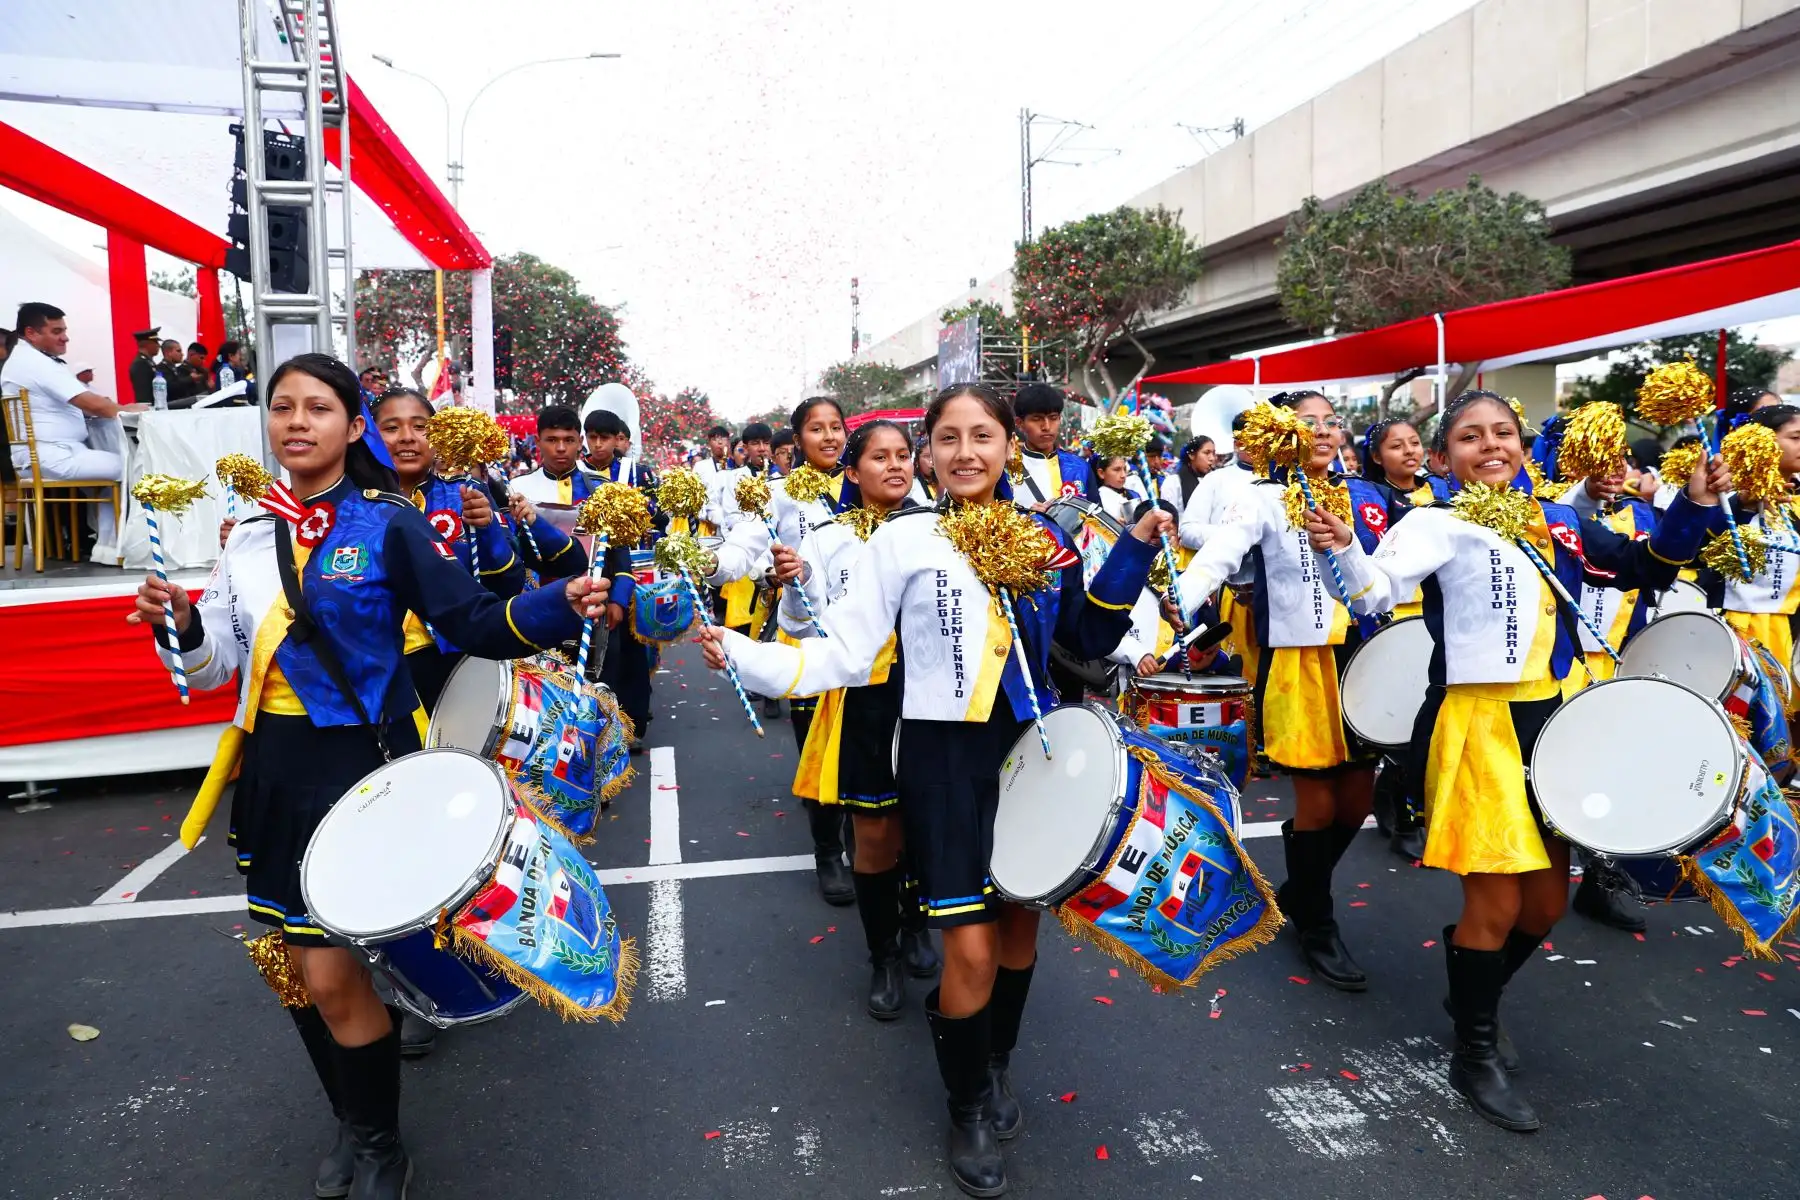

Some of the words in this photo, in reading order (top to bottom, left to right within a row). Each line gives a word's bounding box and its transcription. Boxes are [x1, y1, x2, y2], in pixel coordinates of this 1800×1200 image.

[1297, 531, 1311, 583] COLEGIO
[1489, 549, 1503, 609] COLEGIO
[1770, 536, 1784, 600] BENTENARIO
[935, 569, 949, 637] COLEGIO
[1311, 560, 1324, 629] CENTENARIO
[1504, 566, 1518, 664] BICENTENARIO
[1593, 587, 1606, 630] NTENARI
[230, 594, 250, 655] BICENT
[950, 588, 964, 698] BICENTENARIO
[510, 721, 534, 746] E
[1190, 706, 1205, 724] E
[1191, 729, 1205, 740] DE
[502, 840, 530, 872] E
[1117, 844, 1148, 875] E
[1145, 860, 1170, 885] DE
[560, 880, 570, 892] E
[1178, 880, 1187, 892] E
[517, 886, 538, 949] BANDA
